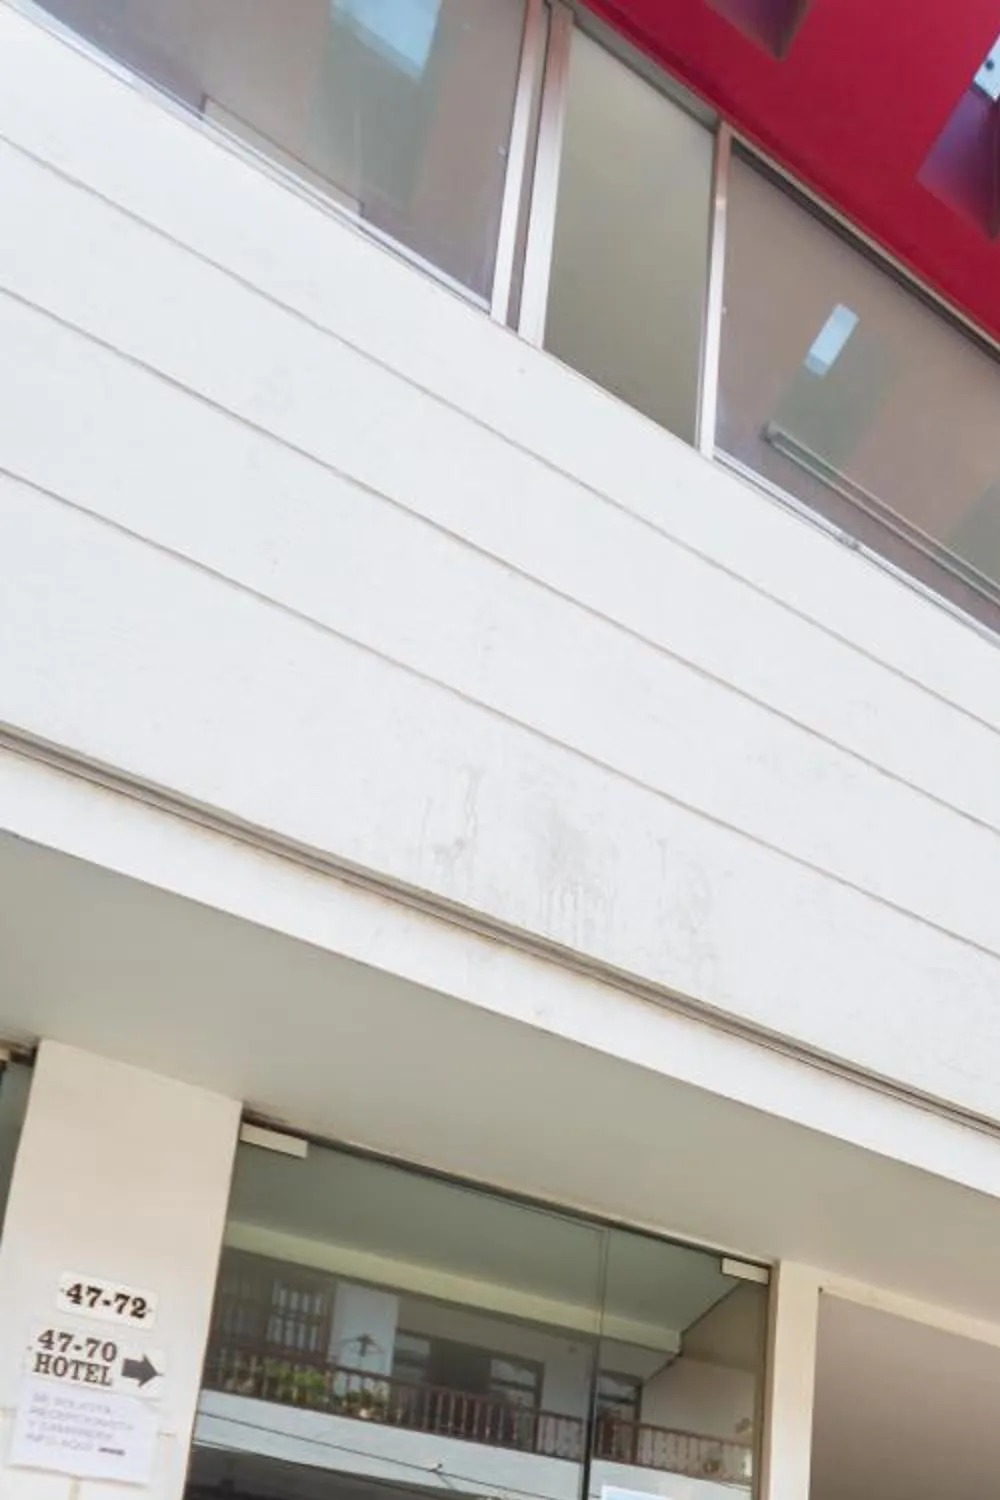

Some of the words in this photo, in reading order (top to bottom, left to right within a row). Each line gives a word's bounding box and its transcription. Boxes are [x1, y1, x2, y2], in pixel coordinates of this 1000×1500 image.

[66, 1283, 147, 1319] 47-72
[38, 1329, 118, 1363] 47-70
[33, 1352, 113, 1387] HOTEL
